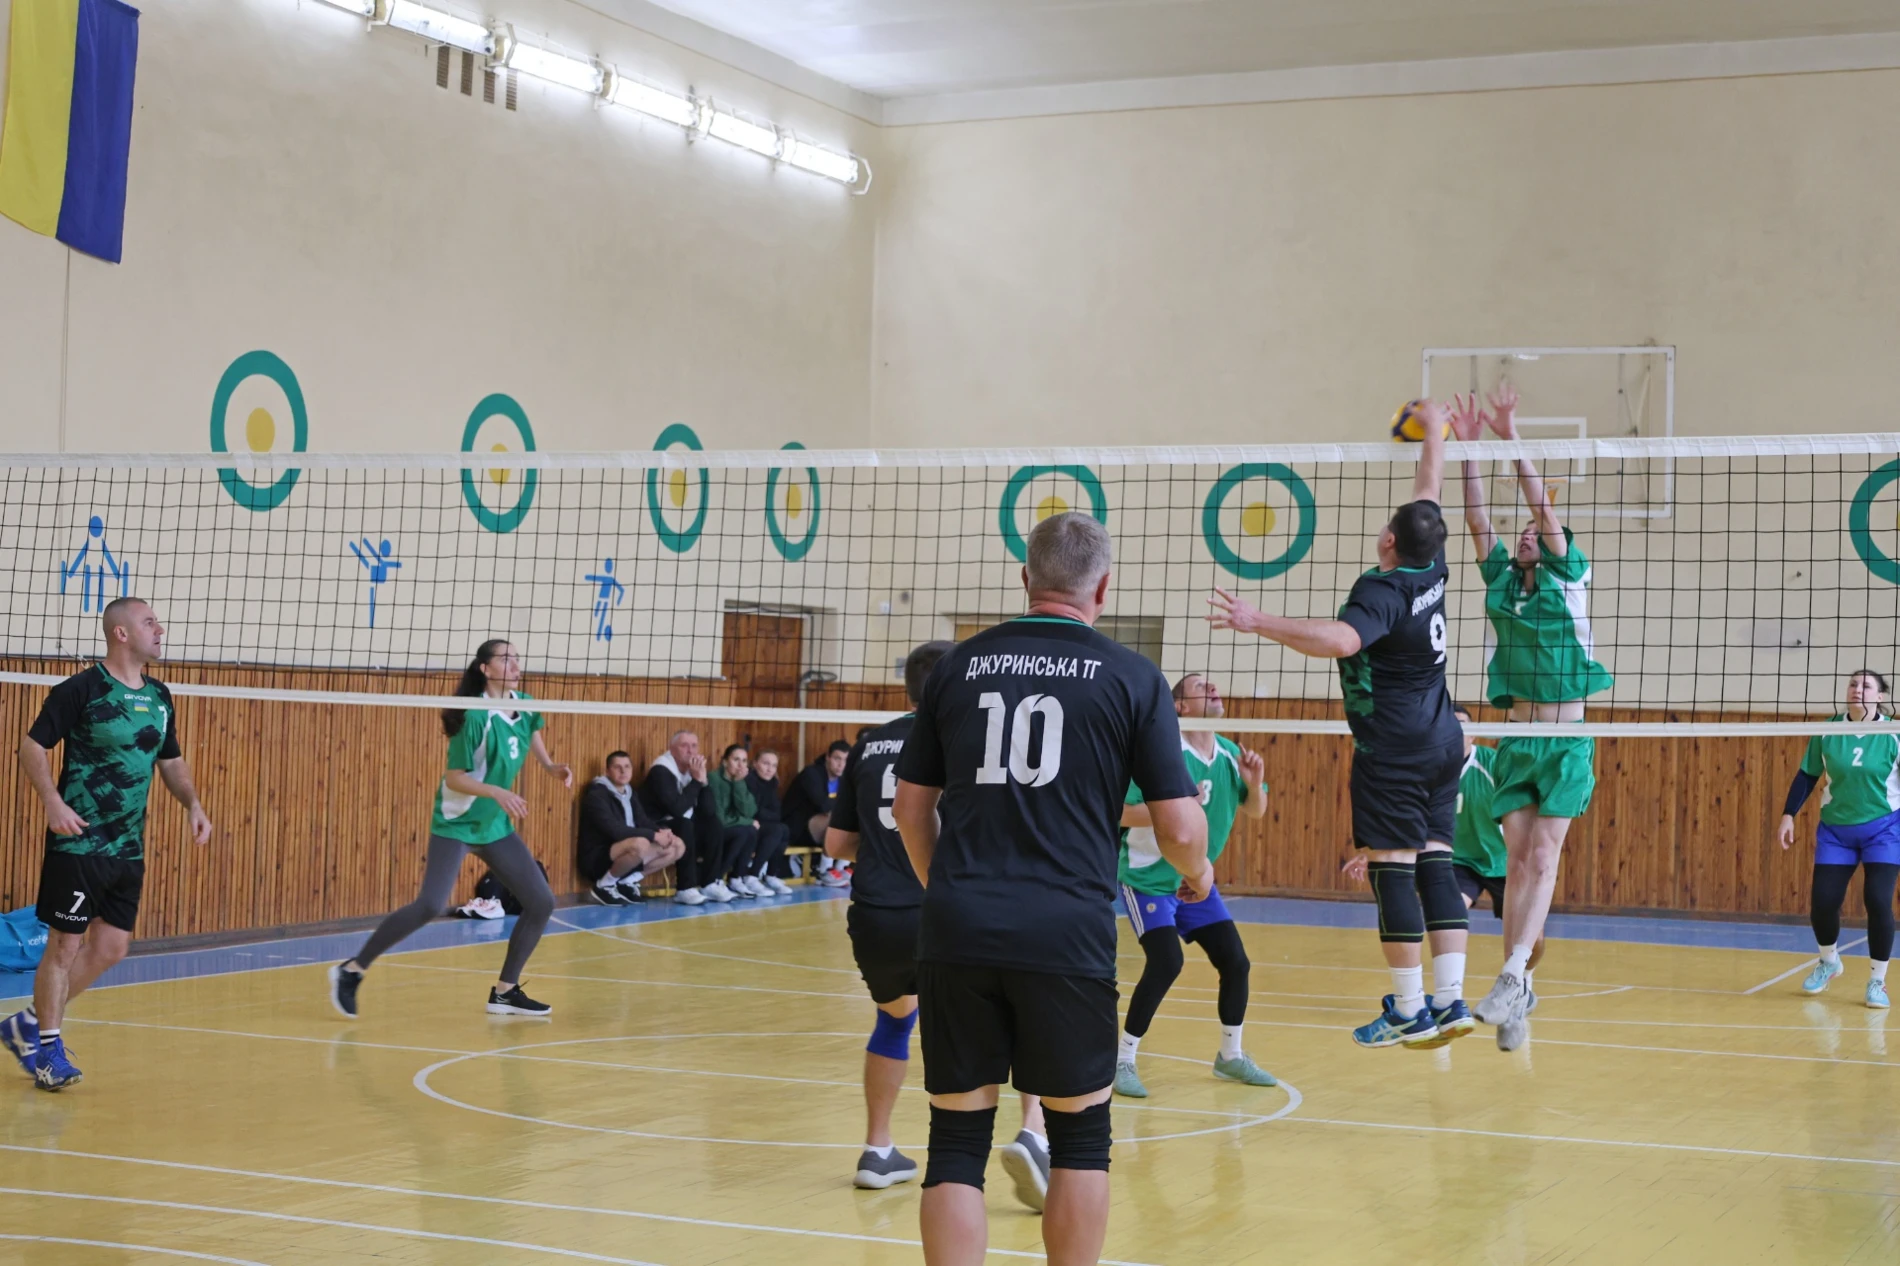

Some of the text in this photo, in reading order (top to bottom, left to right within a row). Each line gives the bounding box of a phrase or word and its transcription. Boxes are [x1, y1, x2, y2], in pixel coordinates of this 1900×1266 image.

[1430, 612, 1446, 665] 9
[965, 654, 1102, 681] ДЖУРИНСЬКА ТГ
[123, 693, 152, 702] GIVOVA
[507, 735, 519, 760] 3
[975, 691, 1065, 788] 10
[1851, 746, 1864, 767] 2
[69, 890, 86, 914] 7
[54, 911, 88, 922] GIVOVA
